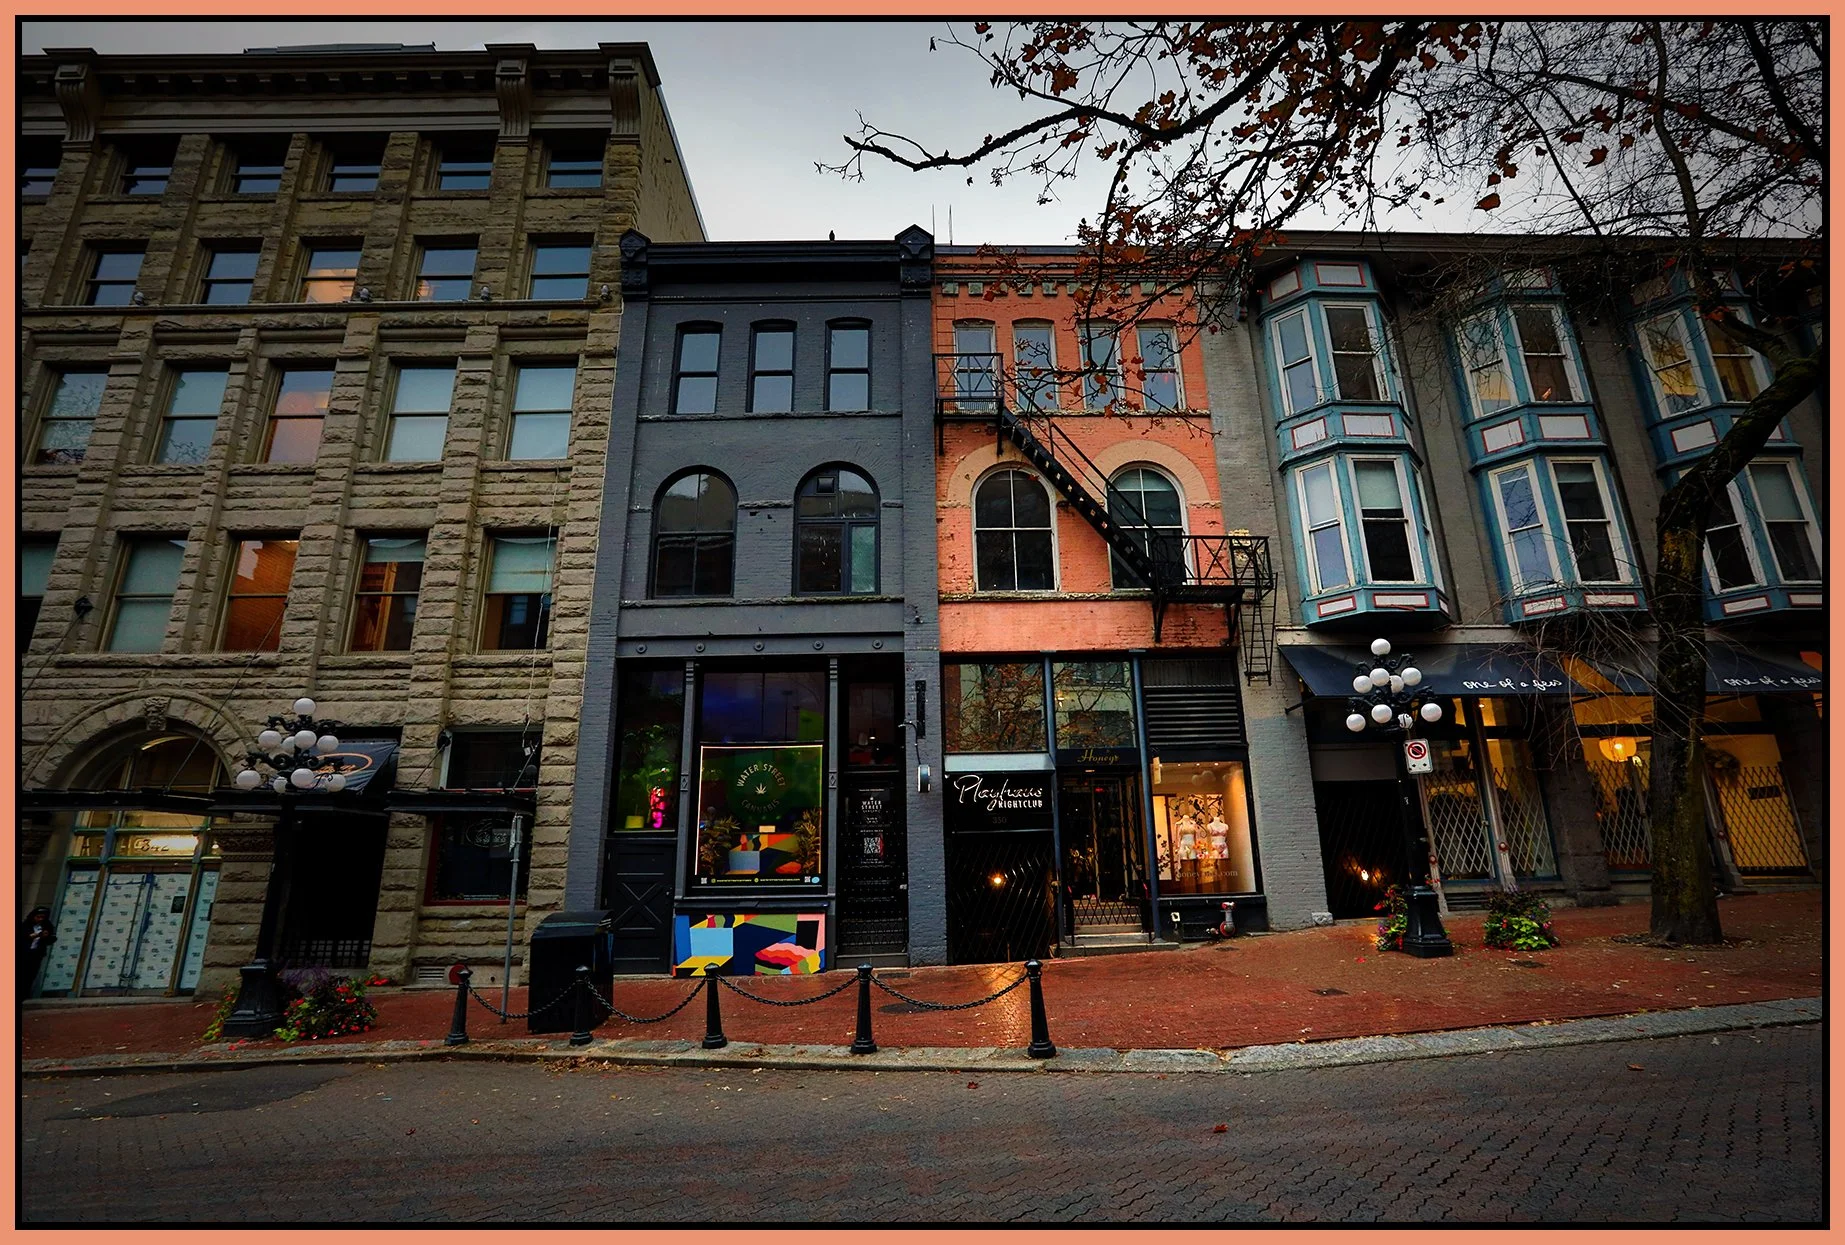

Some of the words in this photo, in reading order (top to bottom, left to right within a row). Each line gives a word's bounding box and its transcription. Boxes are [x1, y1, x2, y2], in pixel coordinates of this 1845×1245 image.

[1462, 680, 1497, 690] one
[1499, 677, 1516, 690] of
[1532, 679, 1563, 692] few
[1723, 678, 1759, 687] one
[1759, 675, 1780, 688] of
[1790, 676, 1821, 688] few
[736, 763, 759, 787] WATER
[762, 763, 786, 787] STREET
[741, 798, 780, 814] CANNABIS
[998, 799, 1043, 809] NIGHTCLUB
[992, 816, 1007, 824] 350
